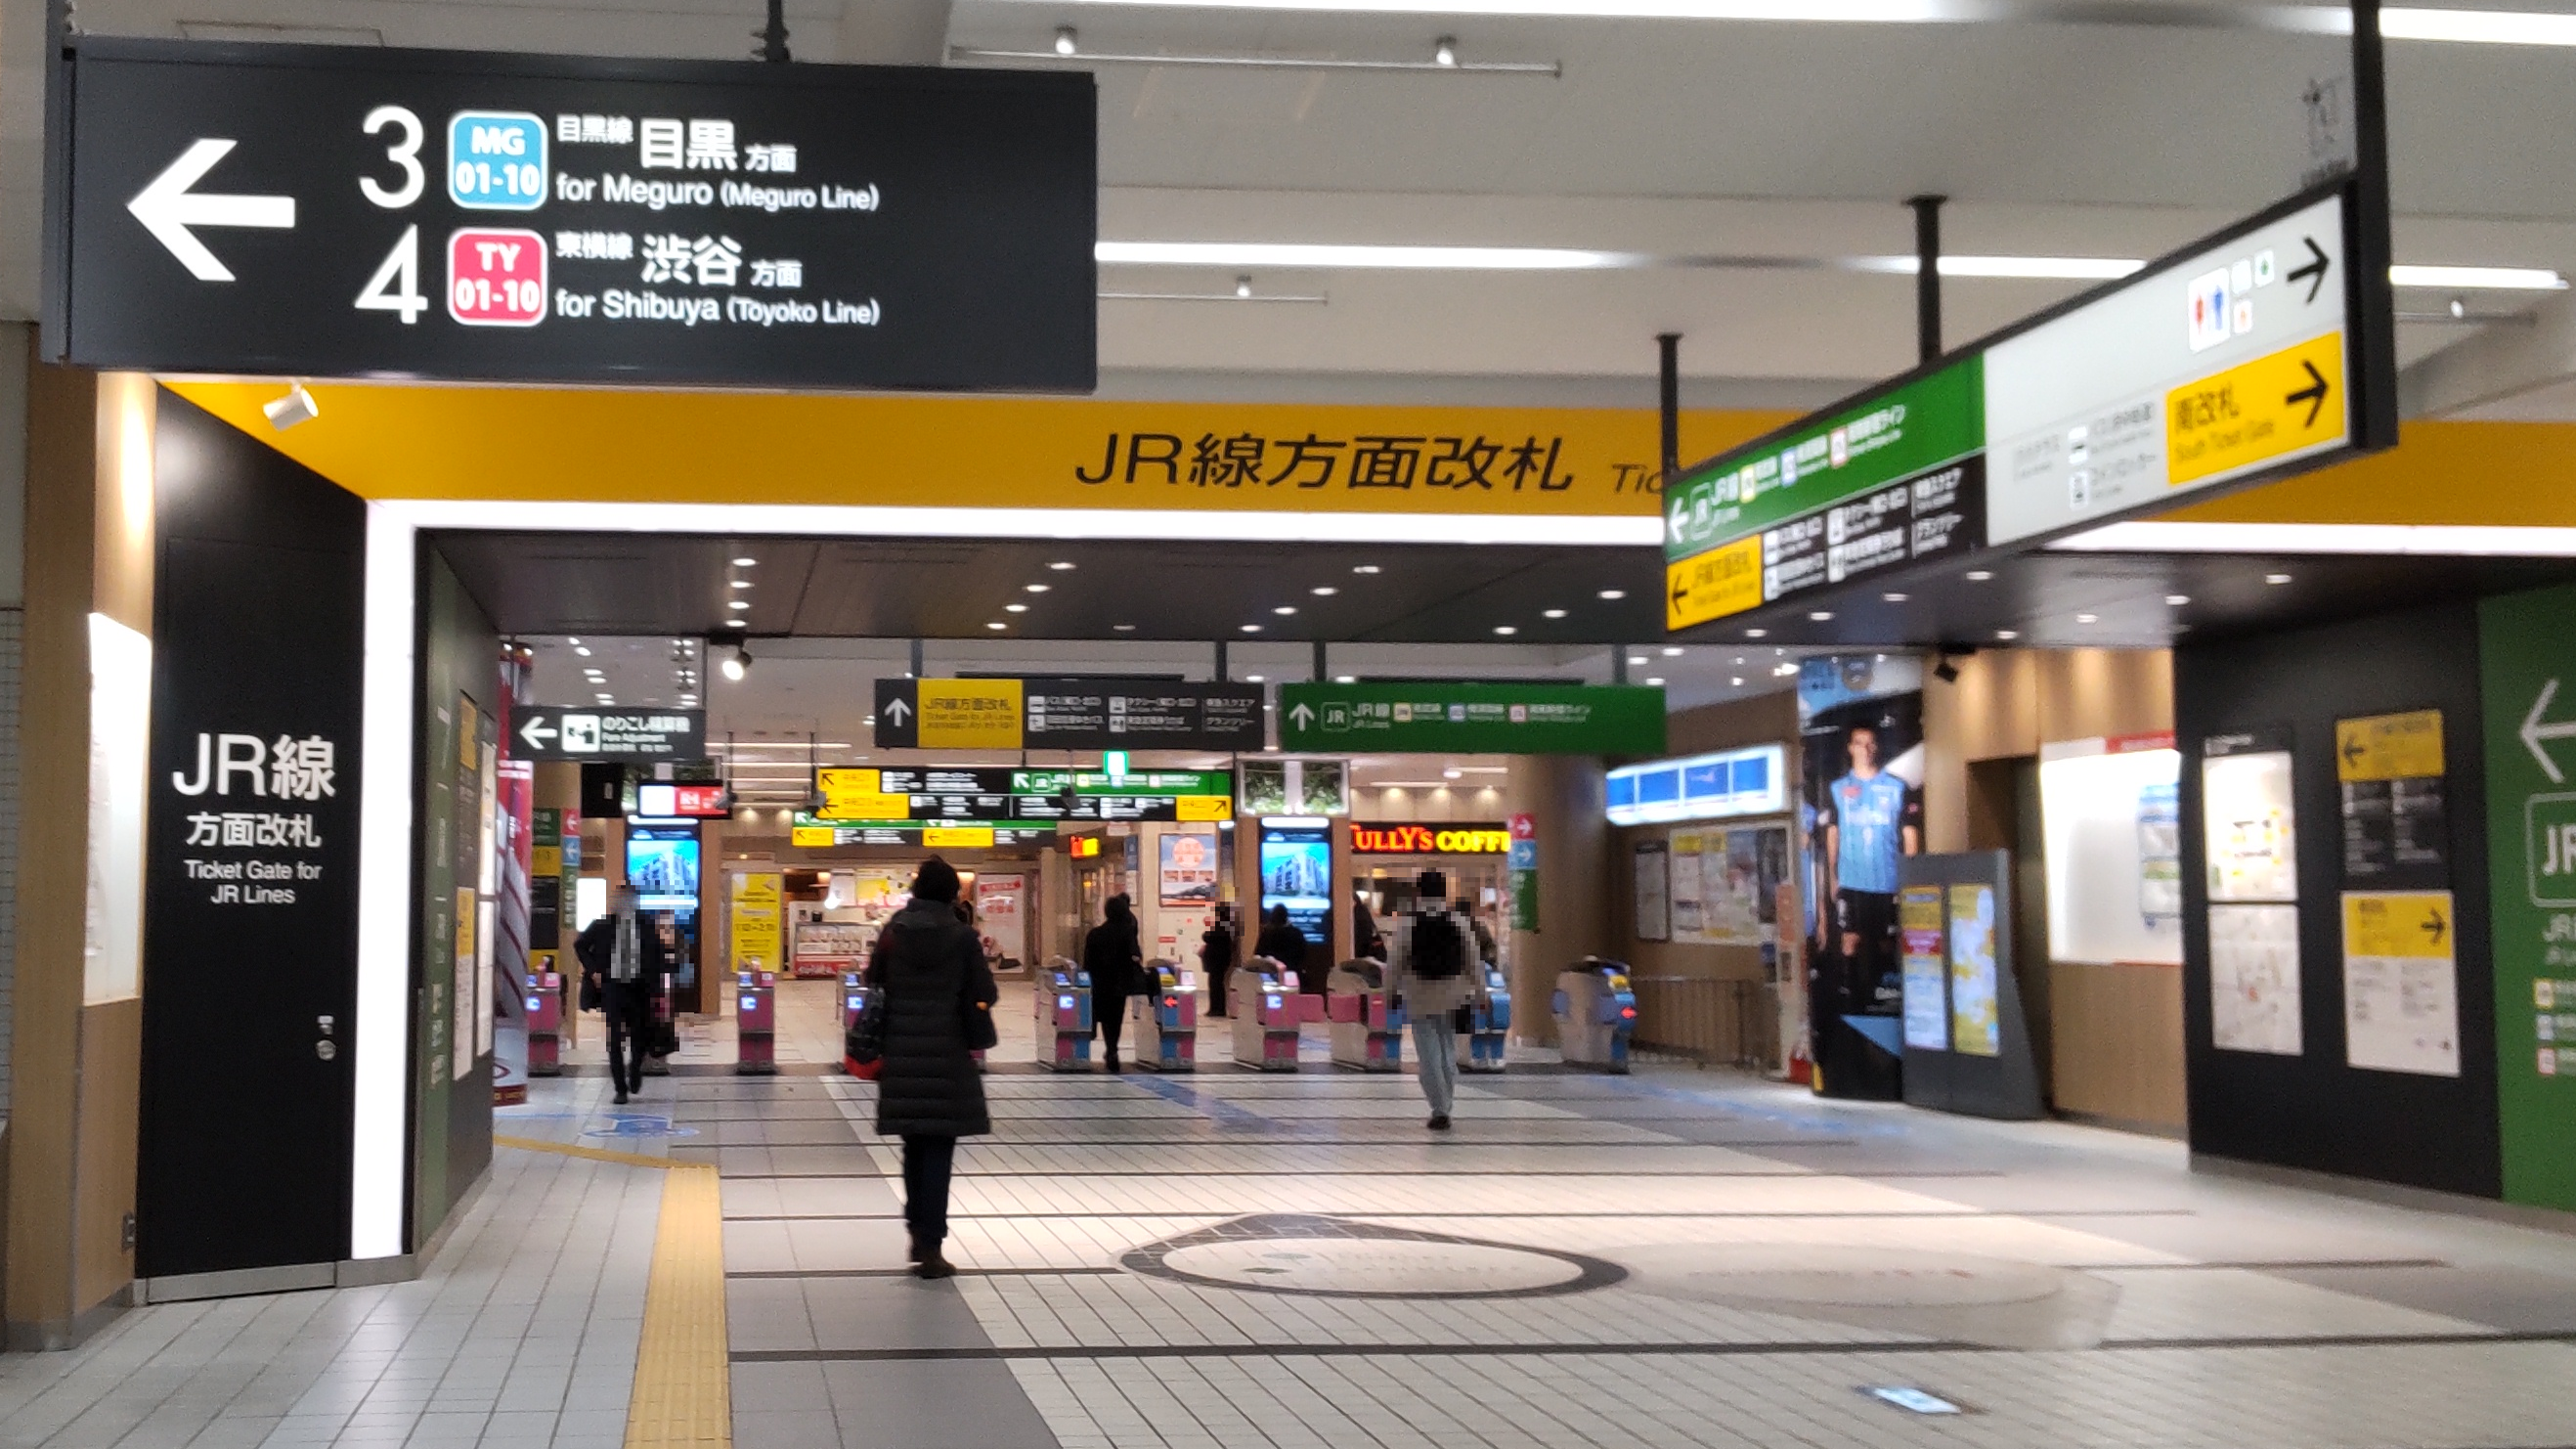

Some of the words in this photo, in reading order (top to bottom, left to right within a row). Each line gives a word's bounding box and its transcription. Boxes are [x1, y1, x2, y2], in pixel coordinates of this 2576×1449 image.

[359, 105, 425, 209] 3
[471, 126, 525, 154] MG
[556, 114, 633, 145] 目黒線
[640, 117, 738, 171] 目黒
[744, 144, 797, 173] 方面
[456, 161, 540, 196] 01-10
[555, 171, 597, 201] for
[602, 173, 714, 210] Meguro
[720, 179, 817, 212] (Meguro
[821, 183, 879, 211] Line)
[354, 224, 428, 325] 4
[475, 242, 521, 272] TY
[554, 230, 634, 260] 東横線
[640, 233, 742, 286] 渋谷
[750, 259, 803, 287] 方面
[455, 278, 540, 312] 01-10
[553, 287, 597, 318] for
[601, 287, 720, 327] Shibuya
[726, 294, 818, 327] (Toyoko
[822, 298, 880, 326] Line)
[1075, 432, 1573, 491] JR線方面改札
[173, 733, 335, 800] JR線
[186, 812, 322, 847] 方面改札
[184, 859, 242, 879] Ticket
[246, 860, 292, 879] Gate
[297, 861, 322, 879] for
[211, 885, 239, 903] JR
[244, 885, 295, 903] Lines
